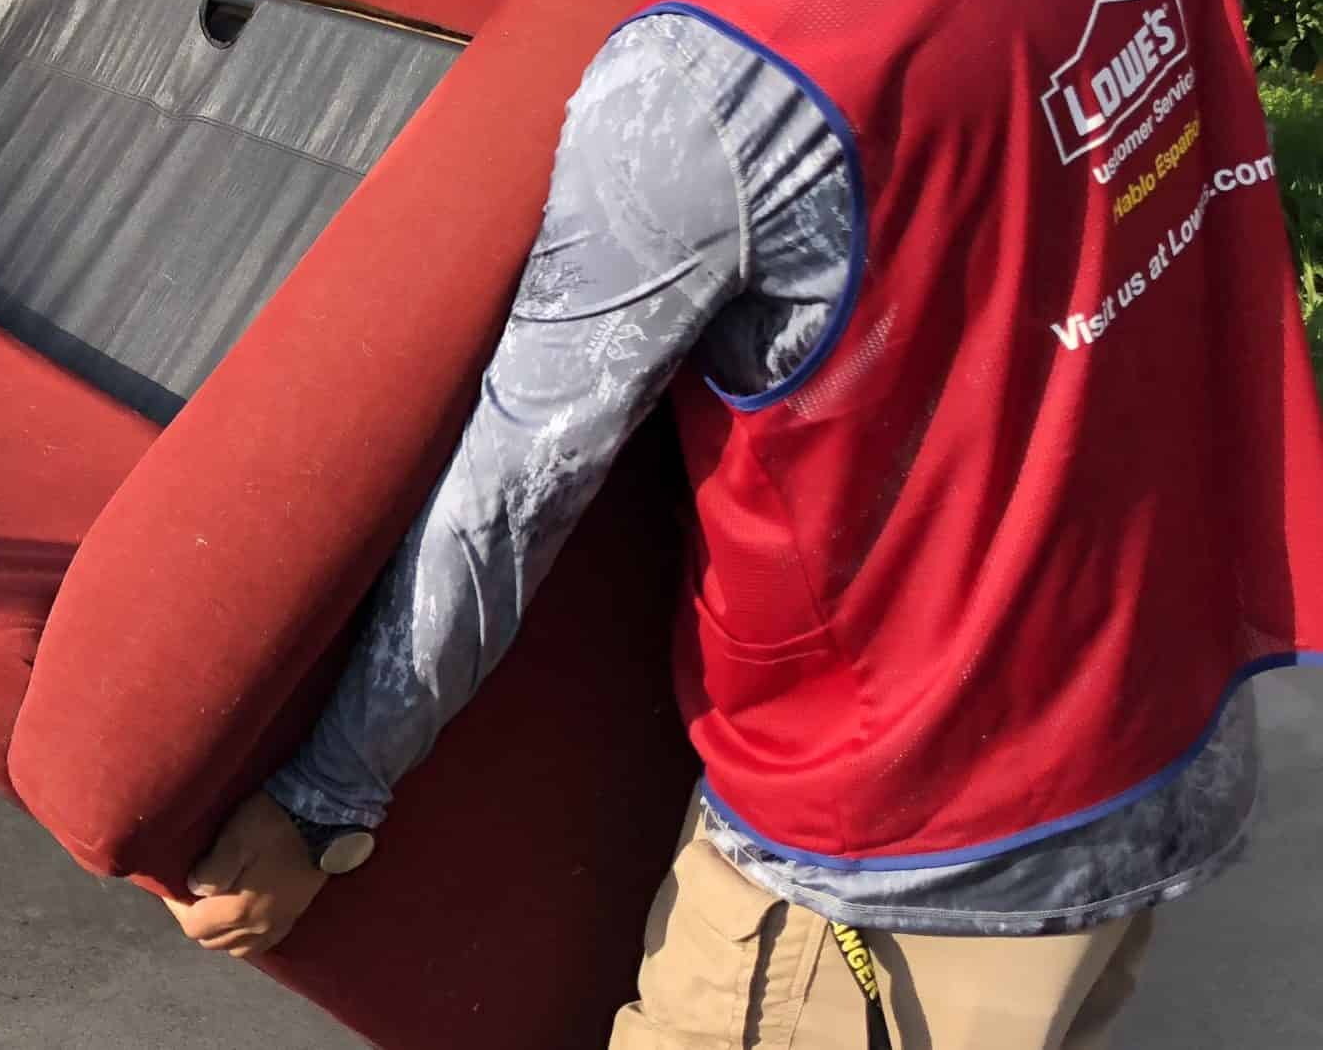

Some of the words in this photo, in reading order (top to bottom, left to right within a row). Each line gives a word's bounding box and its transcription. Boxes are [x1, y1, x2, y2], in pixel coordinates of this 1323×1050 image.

[1063, 8, 1176, 137] LOWE'S
[1092, 115, 1154, 184] ustomer
[1152, 66, 1196, 123] Servic
[1050, 296, 1116, 351] Visit
[1117, 271, 1147, 308] us
[1148, 243, 1170, 281] at
